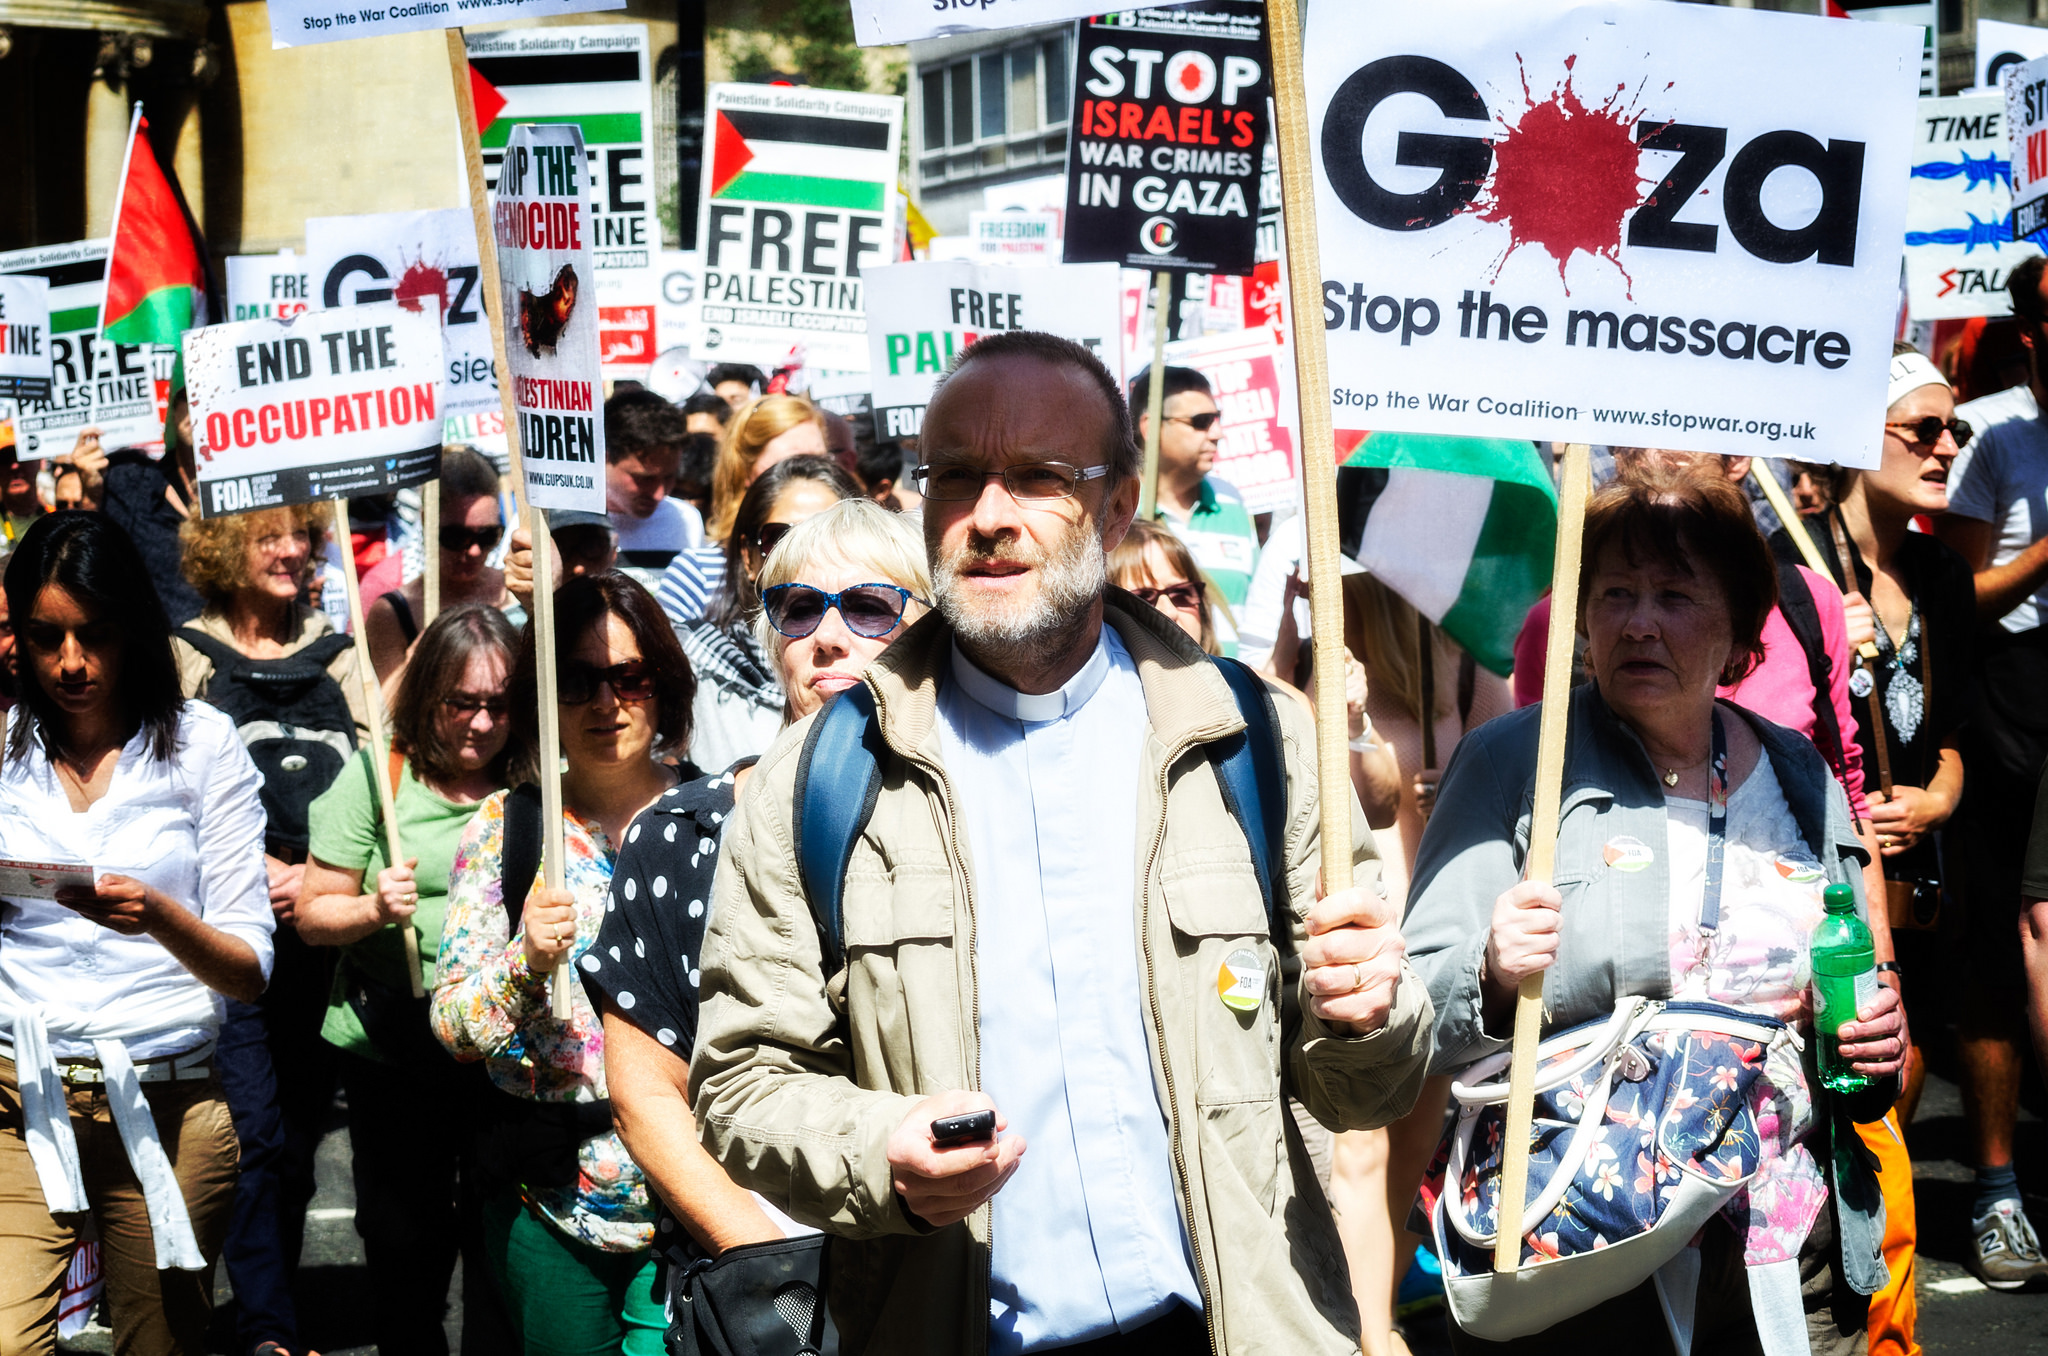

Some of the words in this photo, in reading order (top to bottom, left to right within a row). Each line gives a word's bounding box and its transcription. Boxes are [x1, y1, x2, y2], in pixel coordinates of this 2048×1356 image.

[303, 15, 332, 31] Stop
[335, 12, 357, 26] the
[359, 8, 385, 22] War
[389, 1, 449, 19] Coalition
[519, 36, 576, 51] Solidarity
[579, 35, 640, 49] Campaign
[1085, 46, 1261, 105] STOP
[717, 91, 772, 108] Palestine
[775, 96, 831, 113] Solidarity
[834, 101, 893, 118] Campaign
[1081, 100, 1255, 147] ISRAEL'S
[2025, 79, 2048, 126] ST
[1926, 114, 2001, 143] TIME
[533, 146, 578, 196] THE
[1080, 141, 1144, 169] WAR
[1150, 146, 1252, 177] CRIMES
[1078, 172, 1121, 208] IN
[1132, 176, 1248, 217] GAZA
[496, 201, 581, 250] GENOCIDE
[707, 205, 882, 278] FREE
[2017, 206, 2037, 236] FOA
[704, 273, 864, 311] PALESTIN
[951, 288, 1022, 329] FREE
[1322, 280, 1440, 346] Stop
[1458, 290, 1548, 343] the
[1566, 309, 1851, 369] massacre
[236, 338, 312, 388] END
[321, 325, 397, 375] THE
[206, 382, 436, 452] OCCUPATION
[1333, 388, 1378, 411] Stop
[1387, 391, 1420, 410] the
[1428, 393, 1469, 413] War
[1477, 397, 1578, 421] Coalition
[1593, 408, 1816, 441] www.stopwar.org.uk
[211, 478, 254, 513] FOA
[529, 471, 595, 490] WWW.GUPSUK.CO.UK
[1240, 976, 1252, 988] FOA
